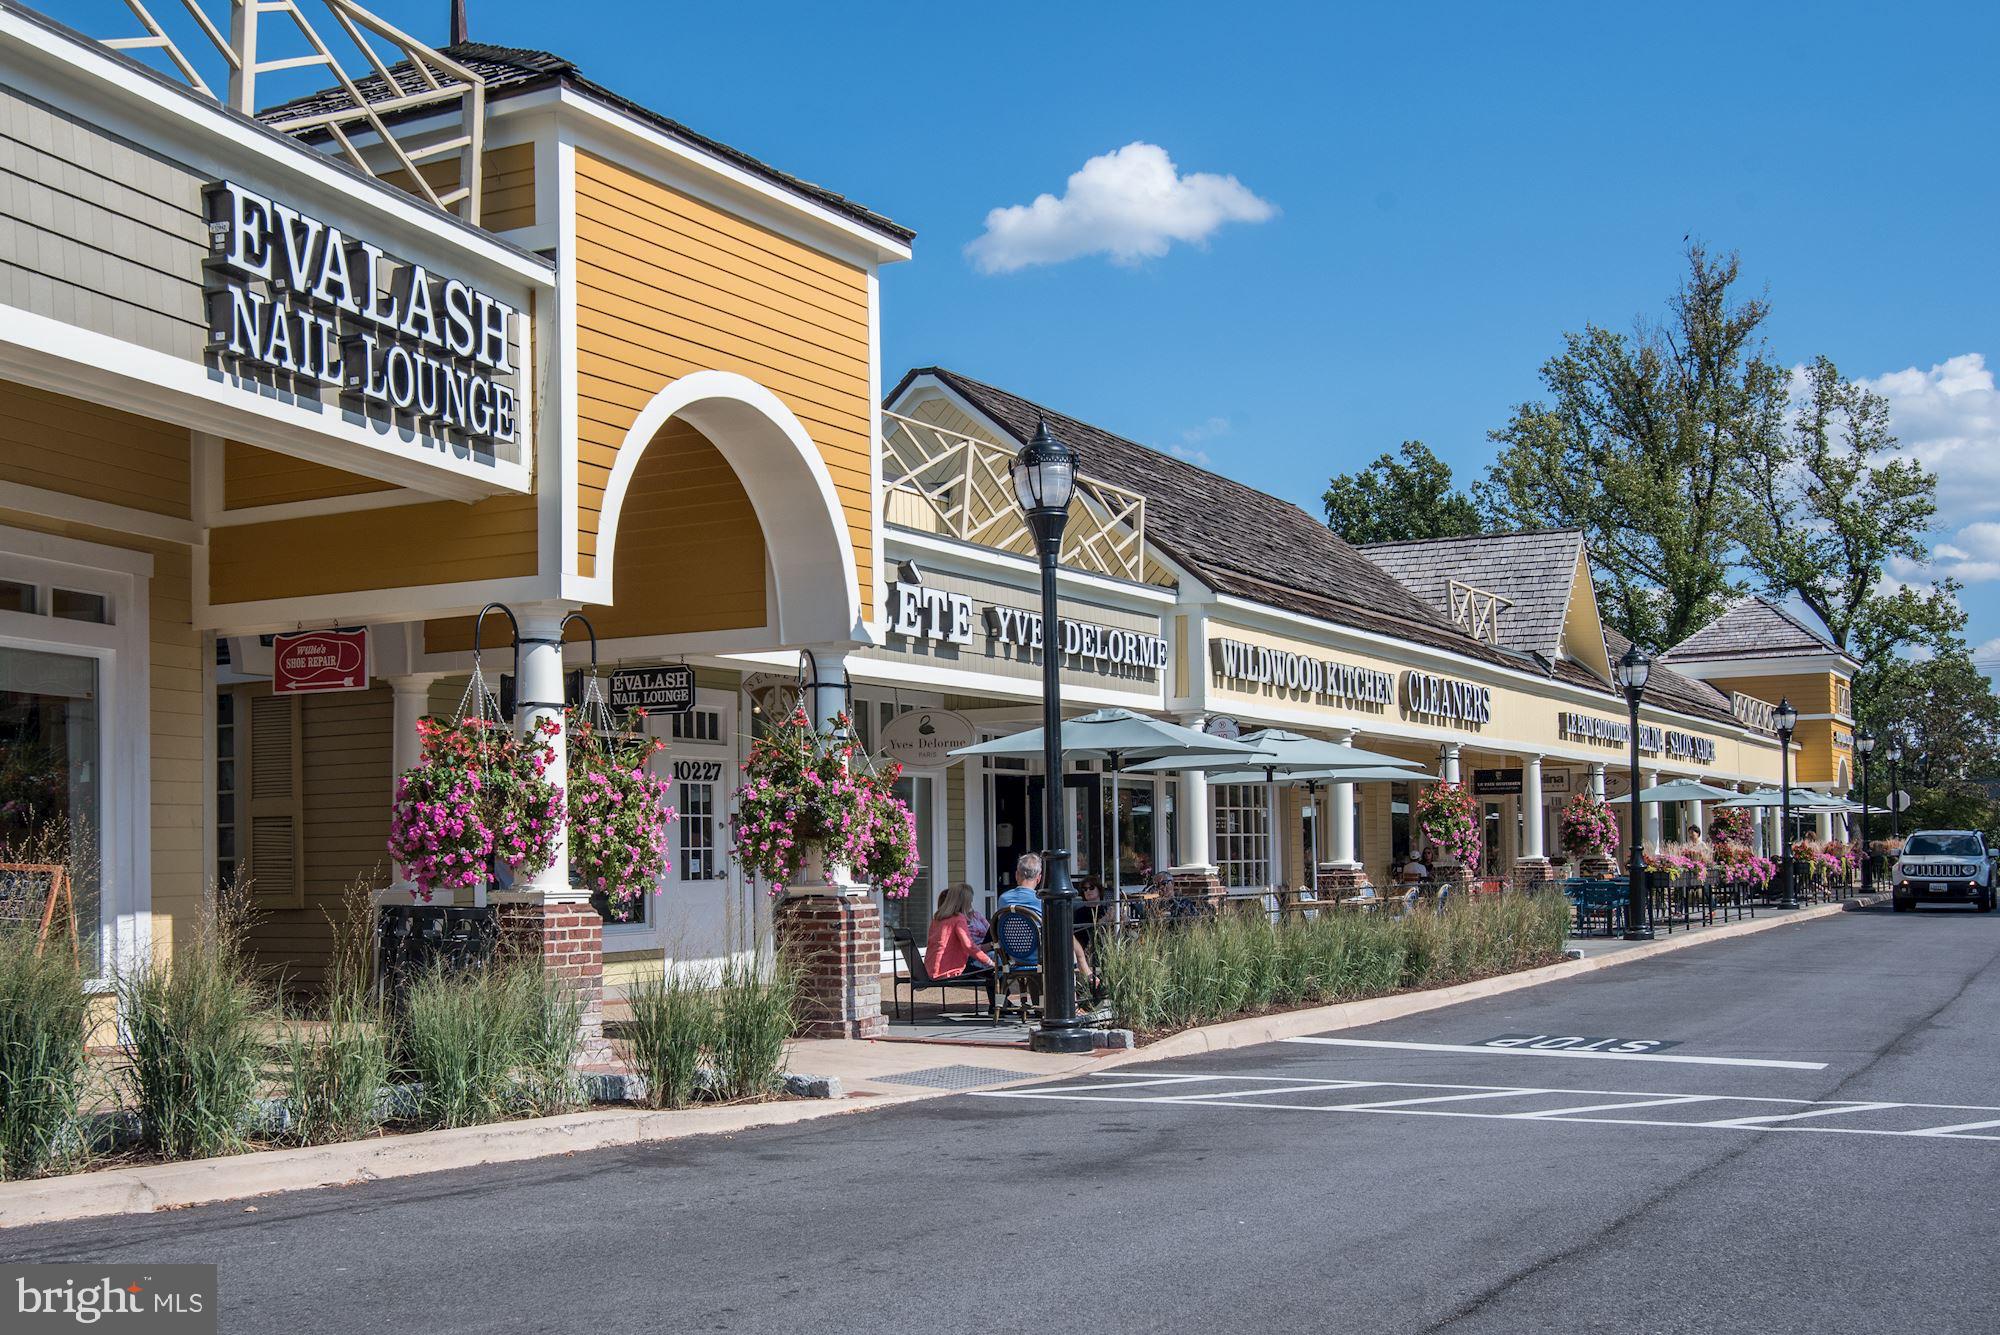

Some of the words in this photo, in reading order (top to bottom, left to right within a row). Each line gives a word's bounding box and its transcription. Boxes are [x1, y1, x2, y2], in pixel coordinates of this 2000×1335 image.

[225, 179, 514, 375] EVALASH
[227, 284, 344, 387] NAIL
[361, 333, 515, 443] LOUNGE
[297, 643, 327, 656] Willie's
[995, 606, 1060, 652] YVE
[1064, 618, 1168, 670] DELORME
[286, 657, 307, 669] SHOE
[307, 655, 337, 668] REPAIR
[1221, 638, 1323, 694] WILDWOOD
[1326, 660, 1395, 705] KITCHEN
[612, 671, 689, 692] ÉVALASH
[612, 692, 640, 705] NAIL
[643, 688, 689, 704] LOUNGE
[1408, 670, 1492, 724] CLEANERS
[1567, 712, 1577, 734] LE
[1577, 714, 1595, 737] PAIN
[890, 739, 913, 750] Yves
[919, 737, 966, 749] Delorme
[1670, 730, 1695, 758] SALON
[673, 760, 722, 781] 10227
[1486, 1035, 1661, 1053] STOP
